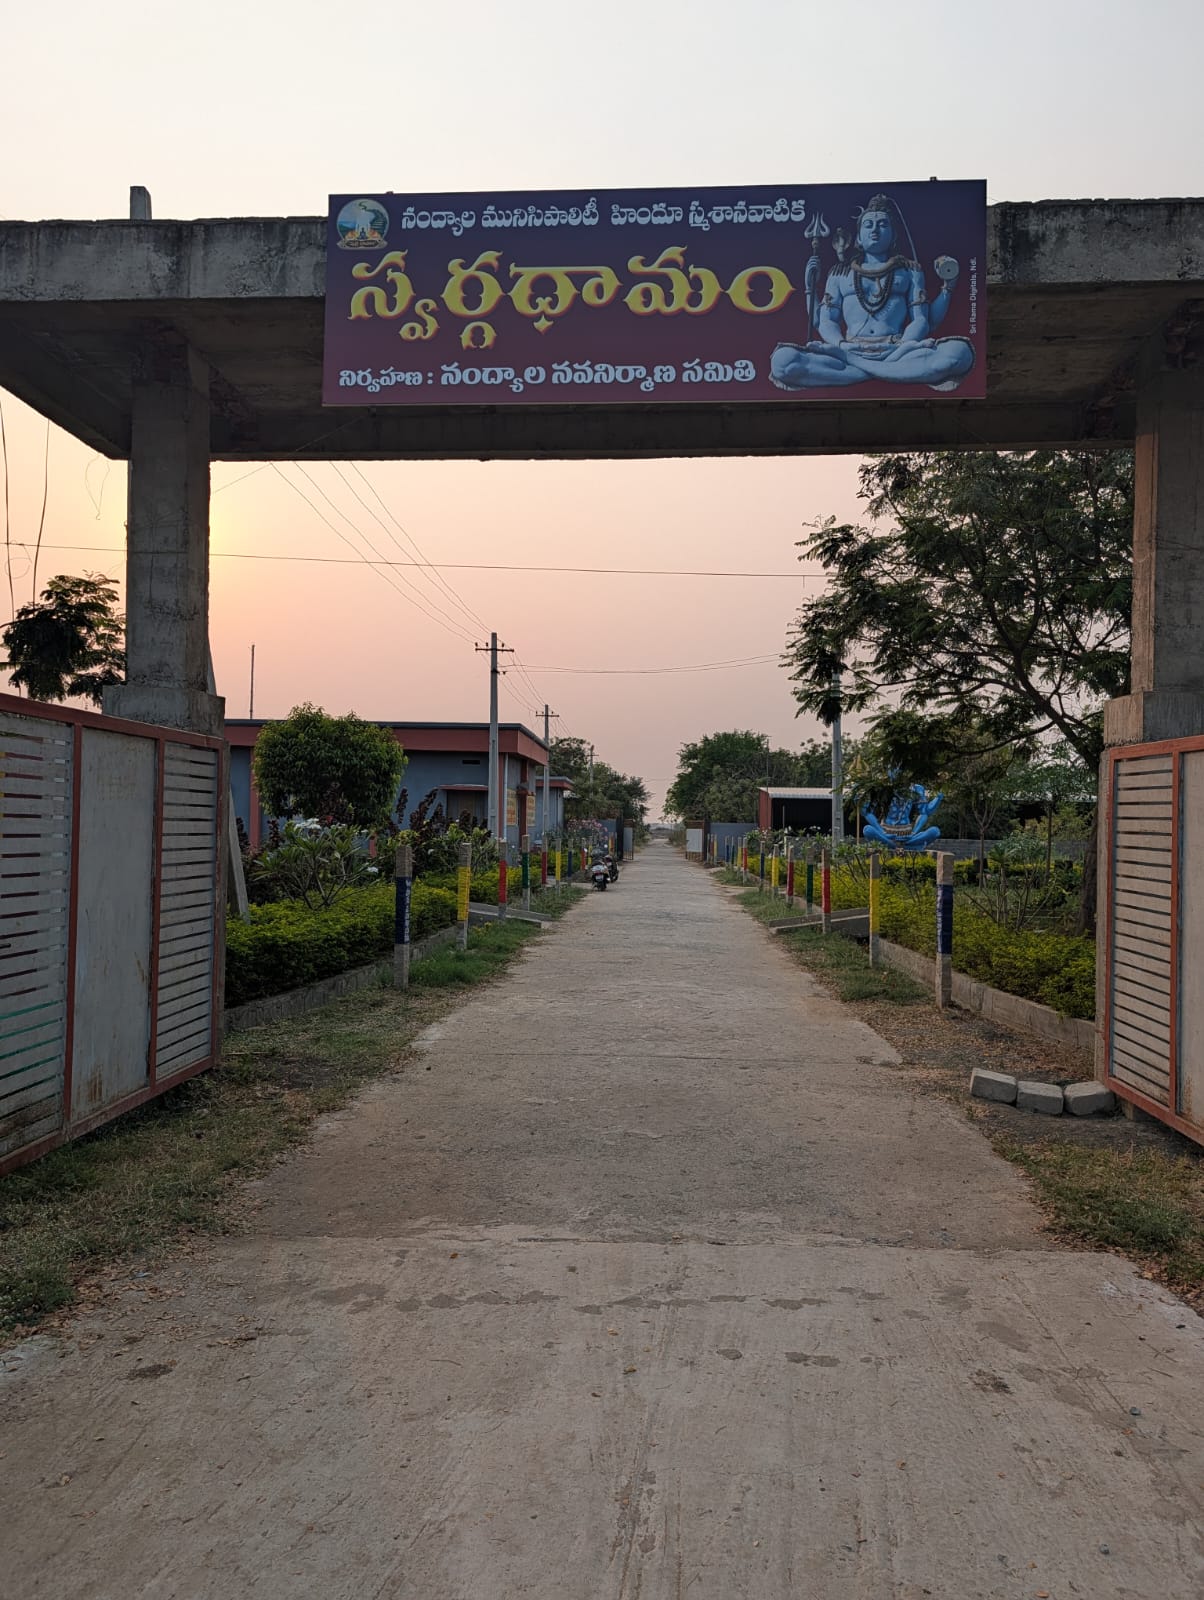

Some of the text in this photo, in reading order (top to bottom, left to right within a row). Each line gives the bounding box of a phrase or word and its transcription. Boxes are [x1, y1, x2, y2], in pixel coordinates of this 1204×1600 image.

[401, 206, 476, 236] నంద్యాల
[481, 197, 600, 228] మునిసిపాలిటీ
[610, 202, 684, 226] హిందూ
[348, 247, 794, 350] స్వర్గధామం
[969, 302, 977, 323] Rama
[440, 362, 547, 393] నంద్యాల
[551, 360, 677, 392] నవనిర్మాణ
[682, 358, 756, 383] సమితి
